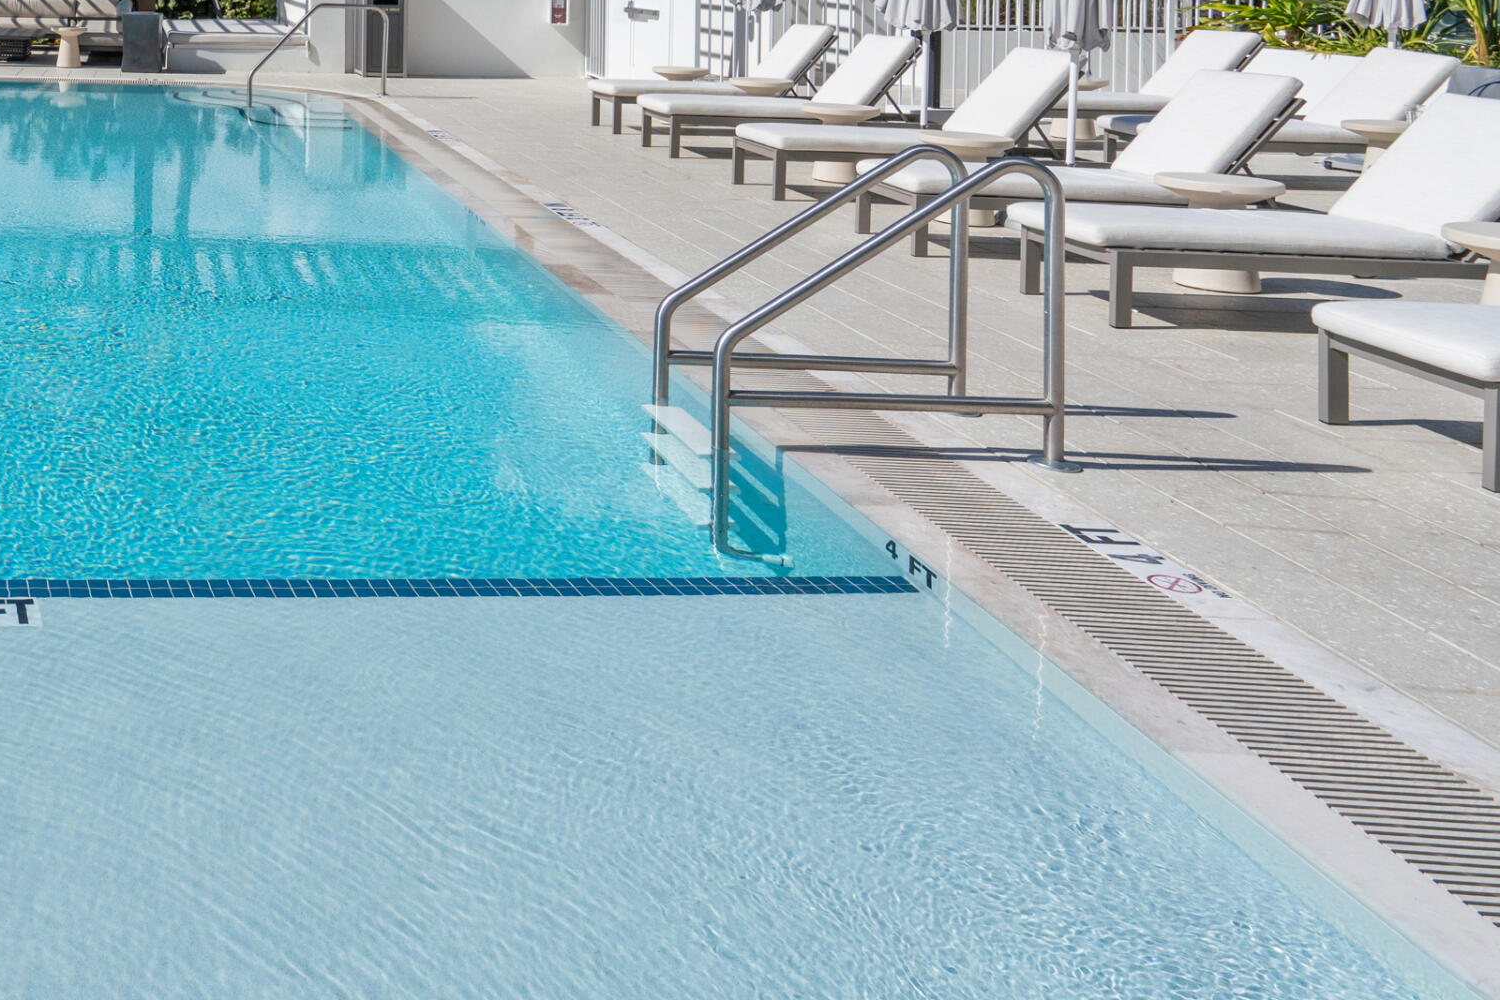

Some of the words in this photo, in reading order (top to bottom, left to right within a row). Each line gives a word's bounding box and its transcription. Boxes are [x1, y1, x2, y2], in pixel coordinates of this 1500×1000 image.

[1059, 524, 1141, 546] FT
[885, 540, 898, 560] 4
[909, 555, 937, 590] FT
[1107, 553, 1165, 565] 4
